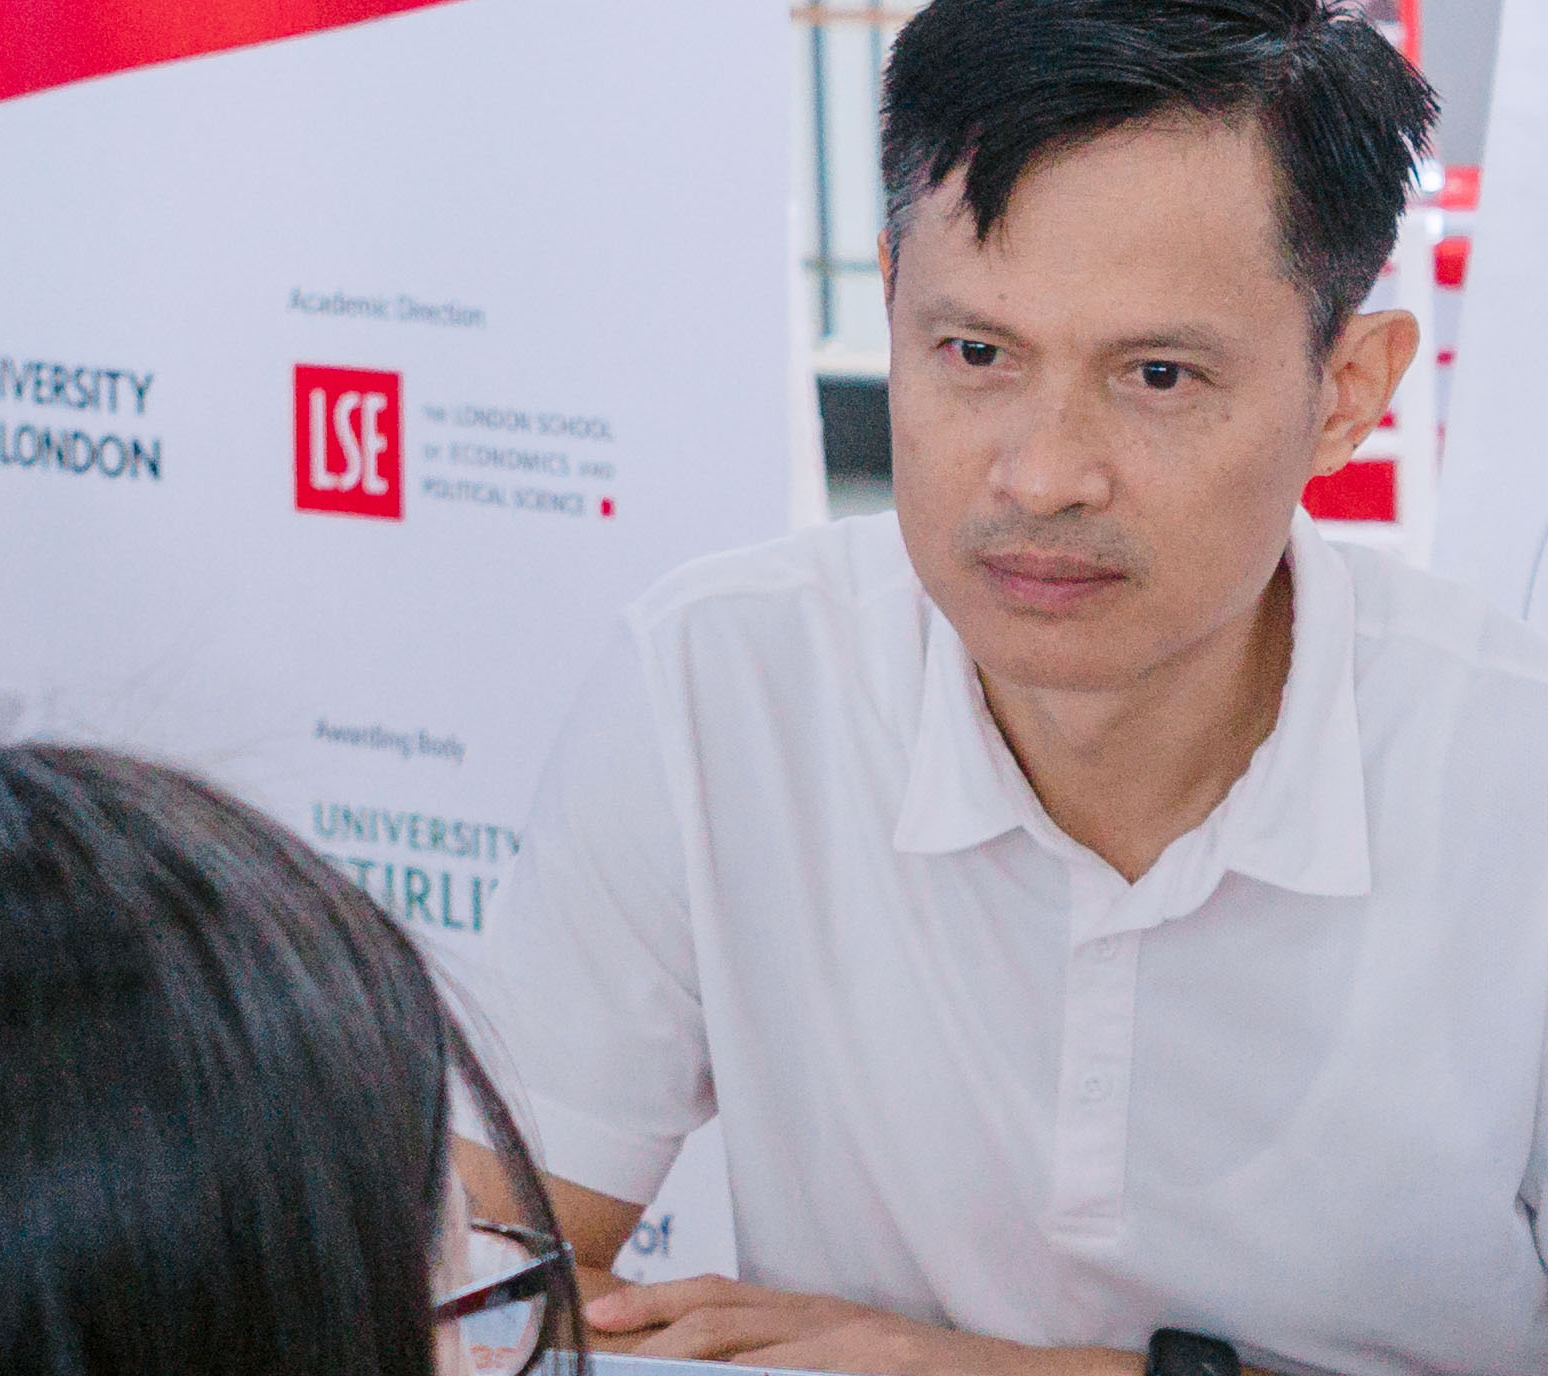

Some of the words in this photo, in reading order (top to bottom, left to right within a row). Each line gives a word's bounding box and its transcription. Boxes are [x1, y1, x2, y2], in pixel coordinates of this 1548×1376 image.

[308, 387, 390, 496] LSE
[312, 802, 521, 862] UNIVERSITY
[318, 850, 500, 935] TIRLI
